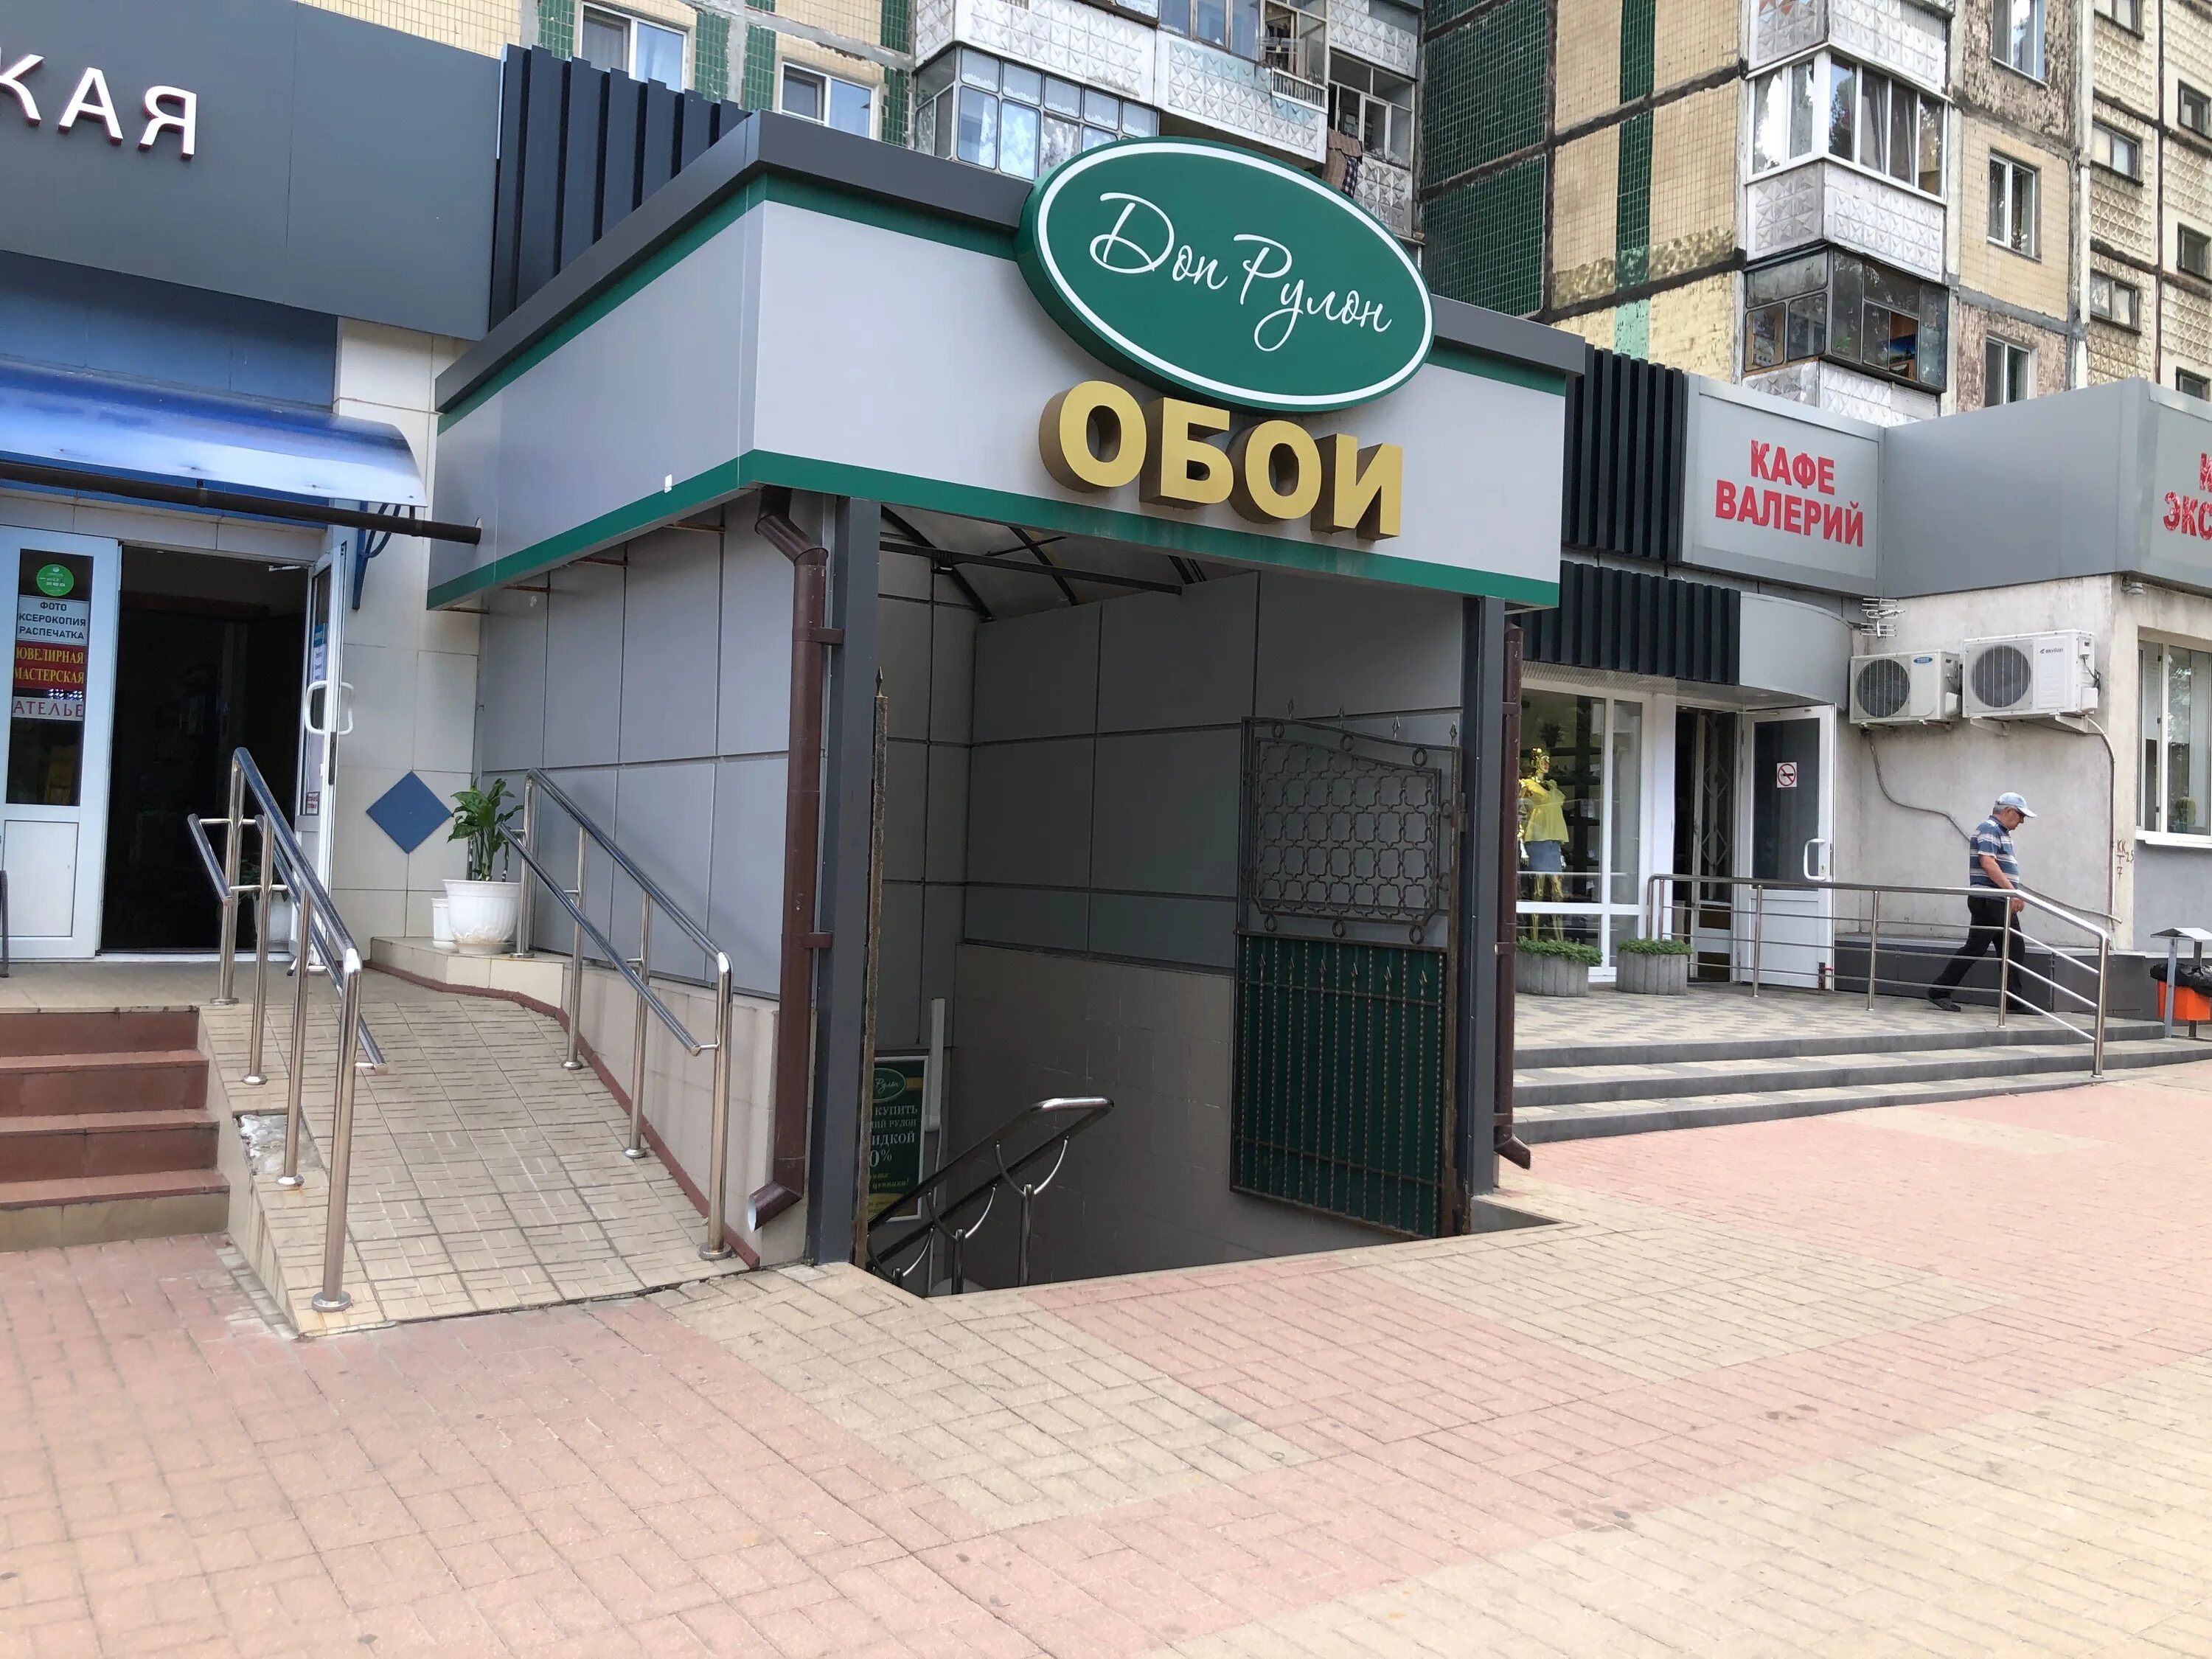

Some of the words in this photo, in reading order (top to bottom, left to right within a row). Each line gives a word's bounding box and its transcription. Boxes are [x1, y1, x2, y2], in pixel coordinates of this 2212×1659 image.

[1234, 234, 1391, 352] Рулон
[1041, 380, 1402, 540] ОБОИ
[1750, 439, 1835, 495] КАФЕ
[1715, 479, 1863, 547] ВАЛЕРИЙ
[40, 601, 67, 611] ФОТО
[19, 613, 86, 627] КСЕРОКОПИЯ
[19, 625, 85, 639] РАСПЕЧАТКА
[16, 647, 83, 664] ЮВЕЛИРНАЯ
[15, 667, 84, 684] МАСТЕРСКАЯ
[13, 700, 83, 717] АТЕЛЬЕ
[875, 1105, 917, 1116] КУПИТЬ
[889, 1119, 917, 1127] РУЛОН
[872, 1130, 915, 1147] ИДКОЙ
[870, 1148, 892, 1167] 0%
